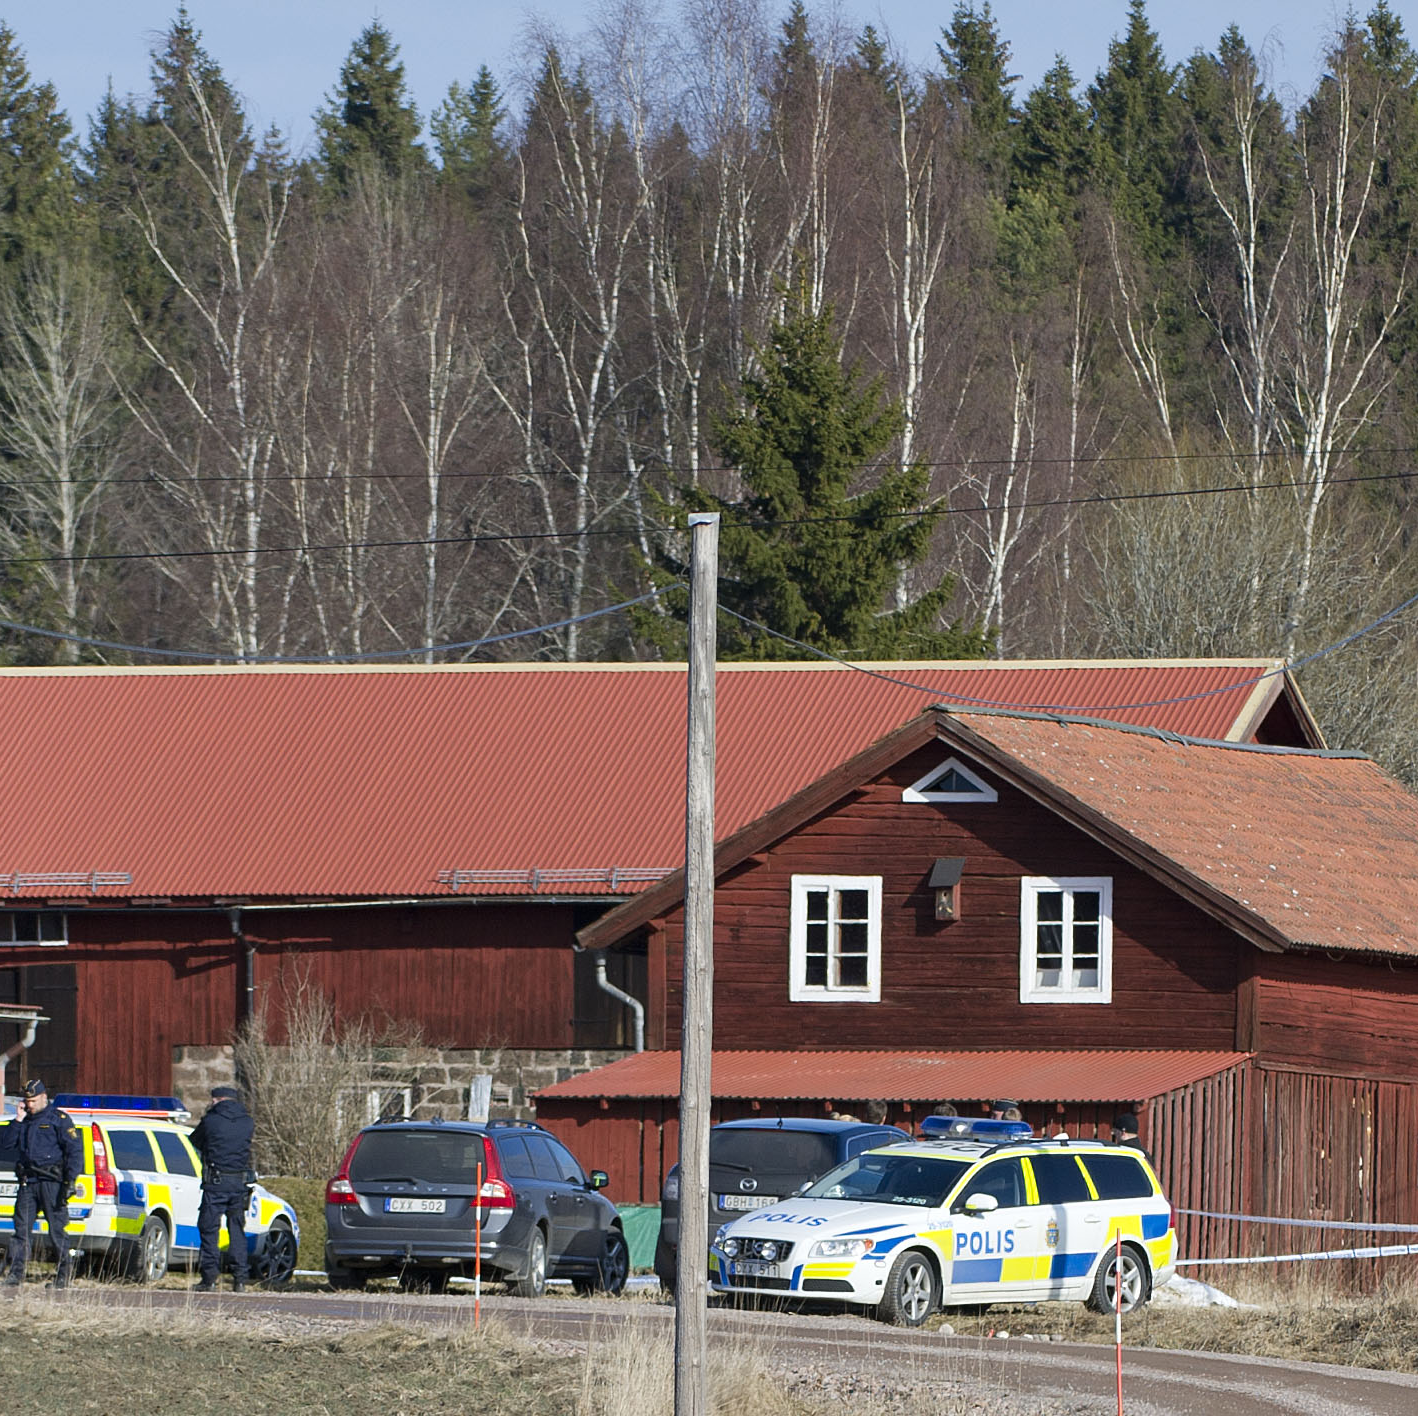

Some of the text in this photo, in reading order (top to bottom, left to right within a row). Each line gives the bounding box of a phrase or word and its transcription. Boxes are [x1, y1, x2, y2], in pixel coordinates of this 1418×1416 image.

[421, 1200, 444, 1211] 502
[725, 1196, 747, 1207] GBH
[748, 1213, 829, 1227] POLIS
[955, 1229, 1015, 1256] POLIS
